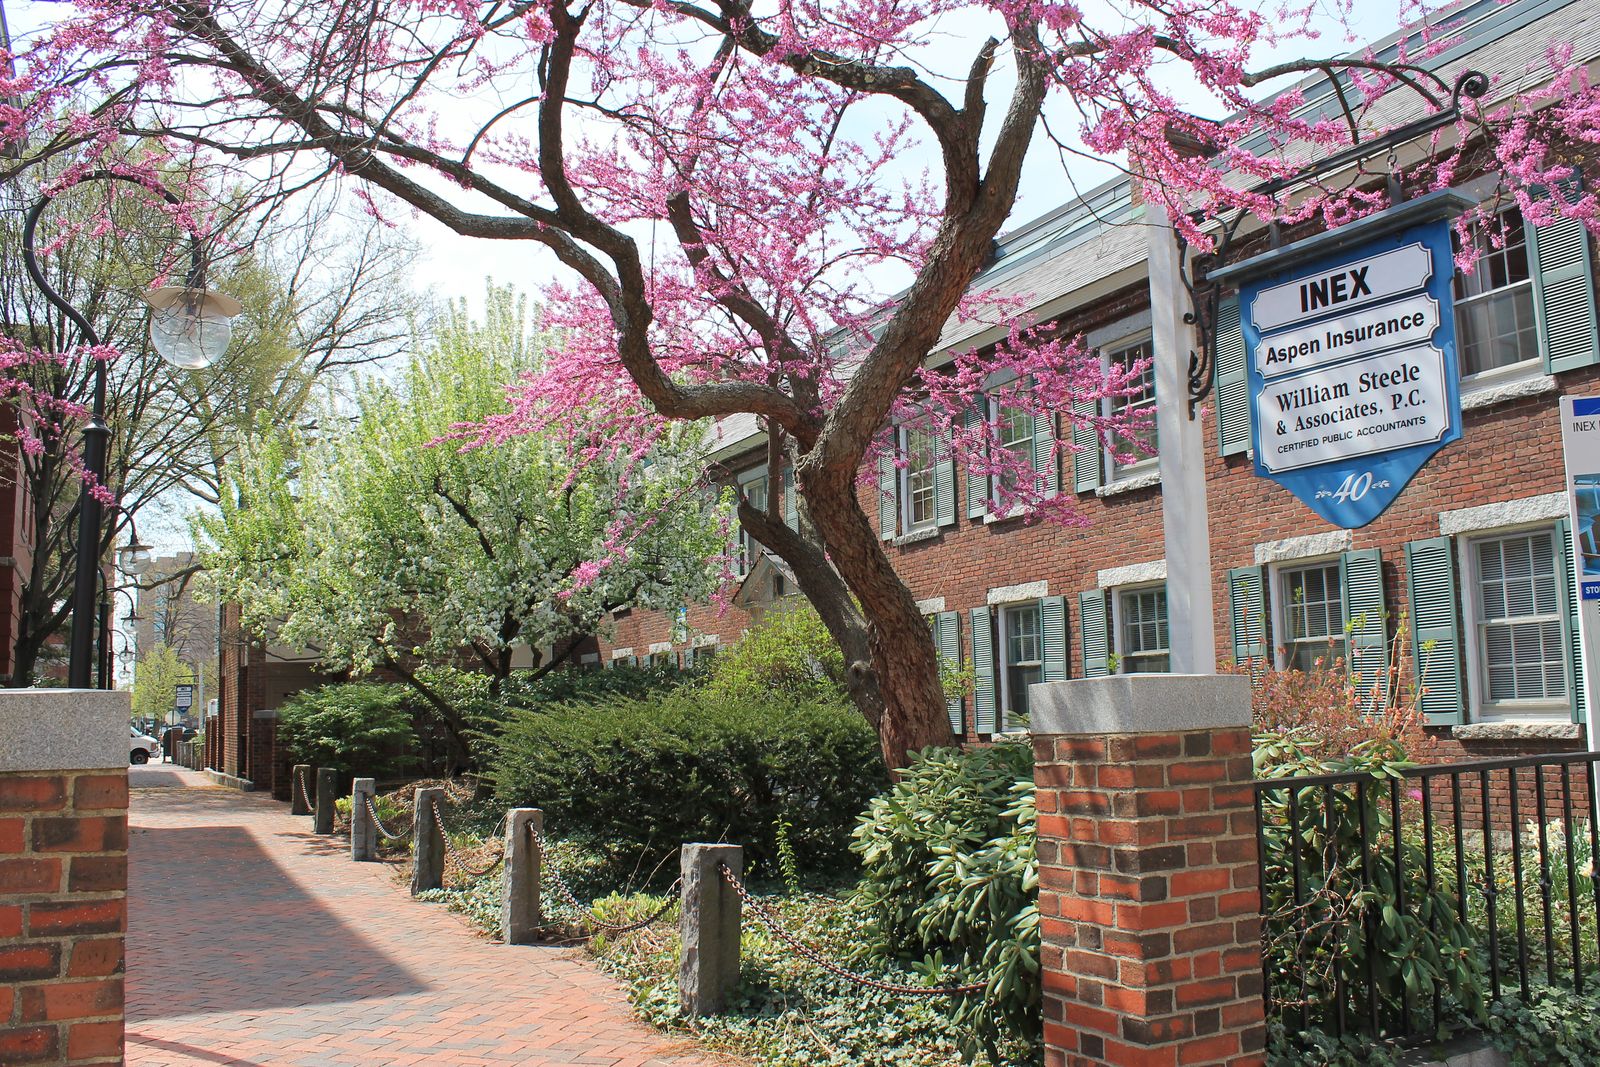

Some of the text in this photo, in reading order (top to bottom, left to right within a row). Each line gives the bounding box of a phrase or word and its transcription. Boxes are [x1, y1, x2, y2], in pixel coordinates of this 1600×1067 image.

[1300, 265, 1372, 313] INEX
[1266, 312, 1425, 365] Aspen Insurance
[1276, 363, 1420, 412] William Steele
[1276, 389, 1426, 436] & Associates, P.C.
[1573, 421, 1596, 432] INEX
[1277, 416, 1426, 454] CERTIFIED PUBLIC ACCOUNTANTS
[1332, 471, 1373, 505] 40
[1585, 586, 1600, 594] STO
